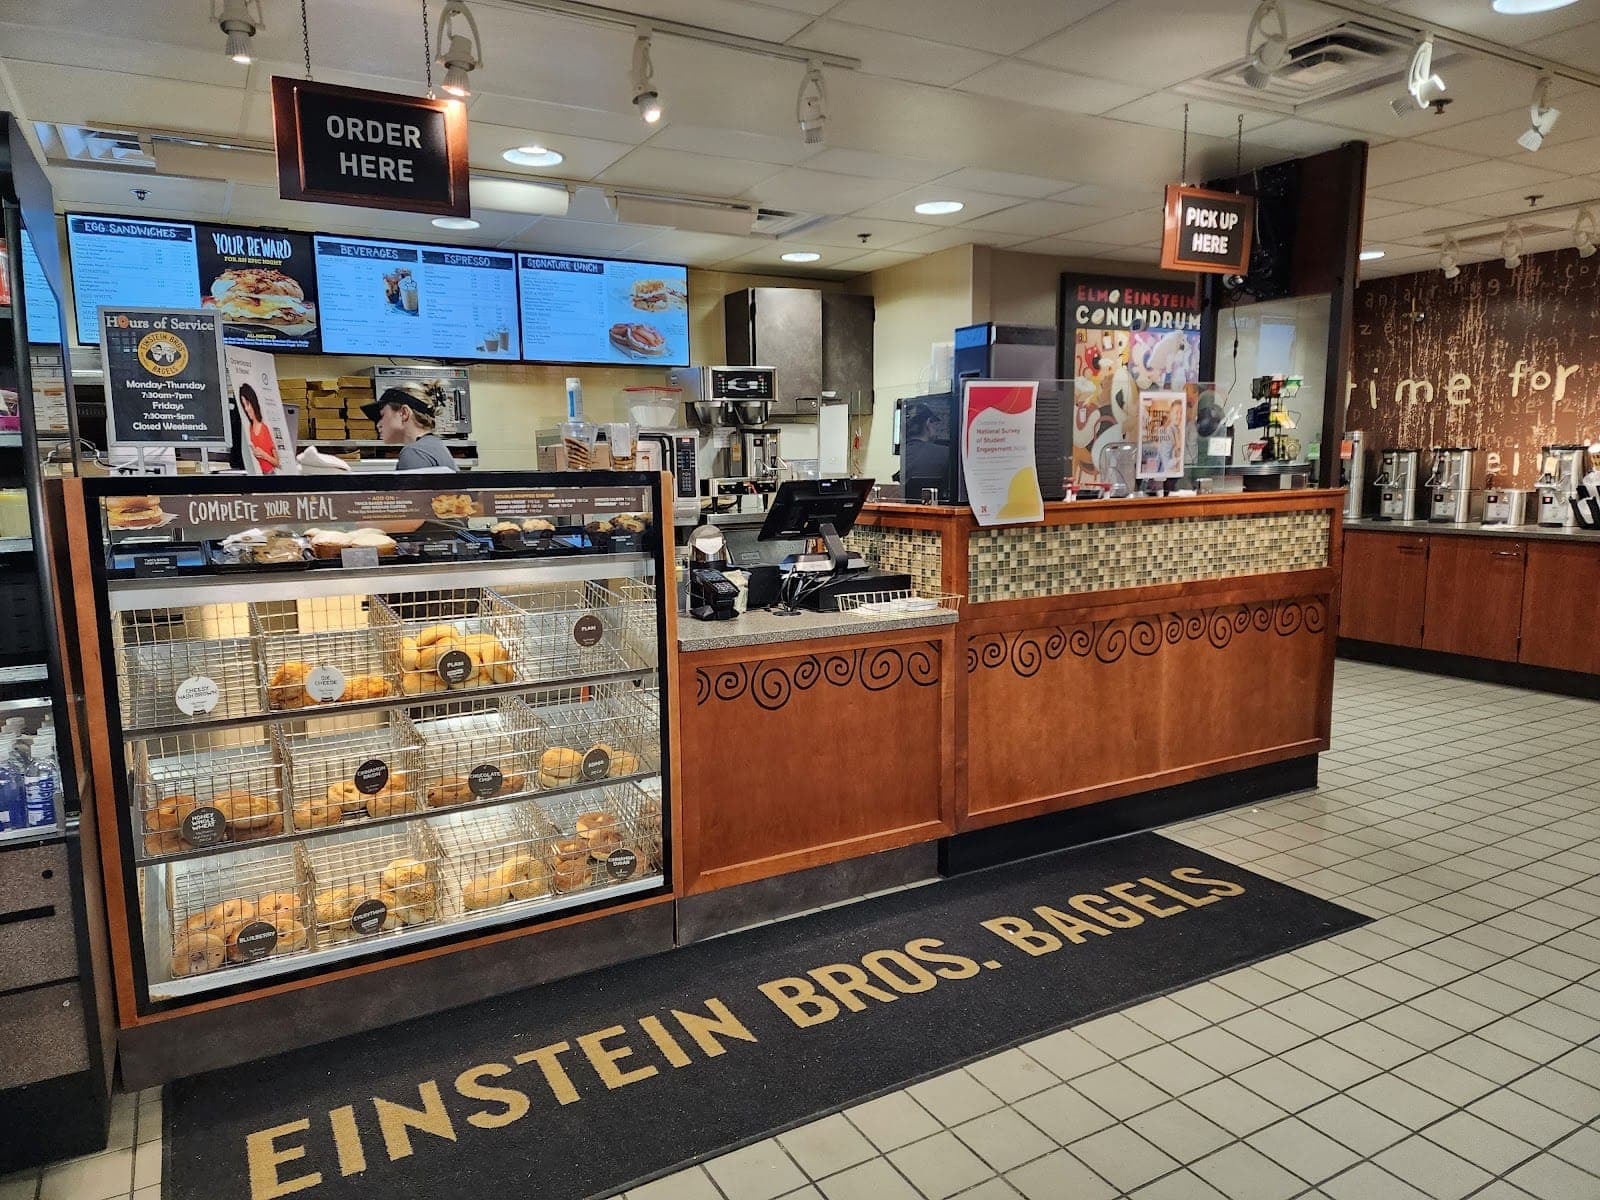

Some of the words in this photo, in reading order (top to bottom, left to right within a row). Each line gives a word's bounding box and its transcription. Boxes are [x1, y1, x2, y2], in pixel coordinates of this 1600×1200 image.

[326, 115, 421, 149] ORDER
[340, 152, 413, 182] HERE
[1186, 207, 1217, 228] PICK
[1219, 211, 1238, 230] UP
[84, 222, 106, 233] EGG
[110, 223, 177, 239] SANDWICHES
[212, 233, 245, 256] YOUR
[246, 236, 292, 259] REWARD
[1192, 233, 1229, 254] HERE
[340, 245, 399, 260] BEVERAGES
[444, 254, 491, 267] ESPRESSO
[527, 257, 571, 270] SIGNATURE
[574, 261, 599, 273] LUNCH
[1077, 284, 1120, 304] ELMO
[106, 314, 150, 329] Hours
[153, 317, 169, 328] of
[171, 319, 214, 331] Service
[1076, 305, 1201, 331] CONUNDRUM
[151, 365, 179, 376] BAGELS
[126, 380, 206, 391] Monday-Thursday
[1345, 367, 1471, 411] time
[1509, 359, 1580, 402] for
[141, 392, 193, 401] 7:30am-7pm
[152, 401, 185, 411] Fridays
[143, 412, 195, 421] 7:30am-5pm
[133, 422, 161, 431] Closed
[163, 423, 207, 432] Weekends
[189, 500, 259, 524] COMPLETE
[264, 501, 291, 518] YOUR
[297, 497, 338, 521] MEAL
[470, 771, 501, 779] CHOCOLATE
[191, 818, 217, 826] WHOLE
[192, 813, 214, 821] HONEY
[192, 822, 215, 831] WHEAT
[239, 931, 276, 944] BLUEBERRY
[246, 997, 757, 1200] EINSTEIN
[758, 936, 1003, 1029] BROS.
[980, 867, 1246, 957] BAGELS
